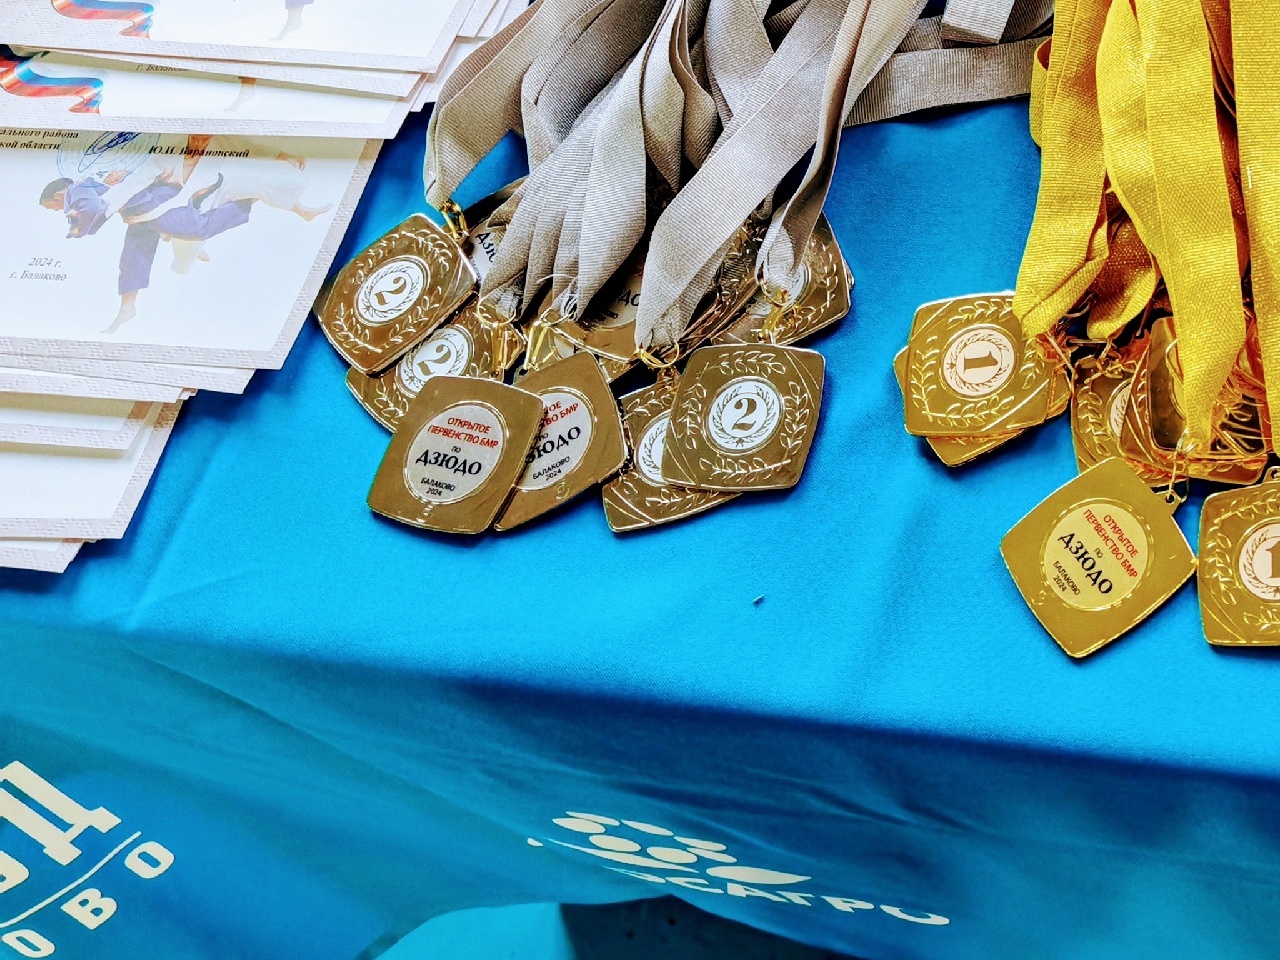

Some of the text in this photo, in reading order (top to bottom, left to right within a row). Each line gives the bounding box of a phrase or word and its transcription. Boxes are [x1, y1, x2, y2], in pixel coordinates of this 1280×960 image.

[20, 141, 61, 150] области
[42, 130, 79, 140] района
[179, 145, 250, 158] Барановский
[28, 257, 54, 267] 2024
[20, 269, 67, 281] Балаково
[375, 276, 407, 306] 2
[416, 343, 451, 377] 2
[963, 351, 999, 374] 1
[560, 403, 579, 418] БМР
[733, 397, 758, 432] 2
[427, 424, 499, 448] ПЕРВЕНСТВО БМР
[447, 417, 491, 434] ОТКРЫТОЕ
[415, 449, 482, 476] ДЗЮДО
[532, 456, 570, 479] БАЛАКОВО
[1083, 509, 1138, 577] ПЕРВЕНСТВО БМР
[1103, 514, 1139, 558] ОТКРЫТОЕ
[1057, 533, 1113, 594] ДЗЮДО
[1052, 560, 1081, 596] БАЛАКОВО
[1053, 574, 1067, 592] 2024
